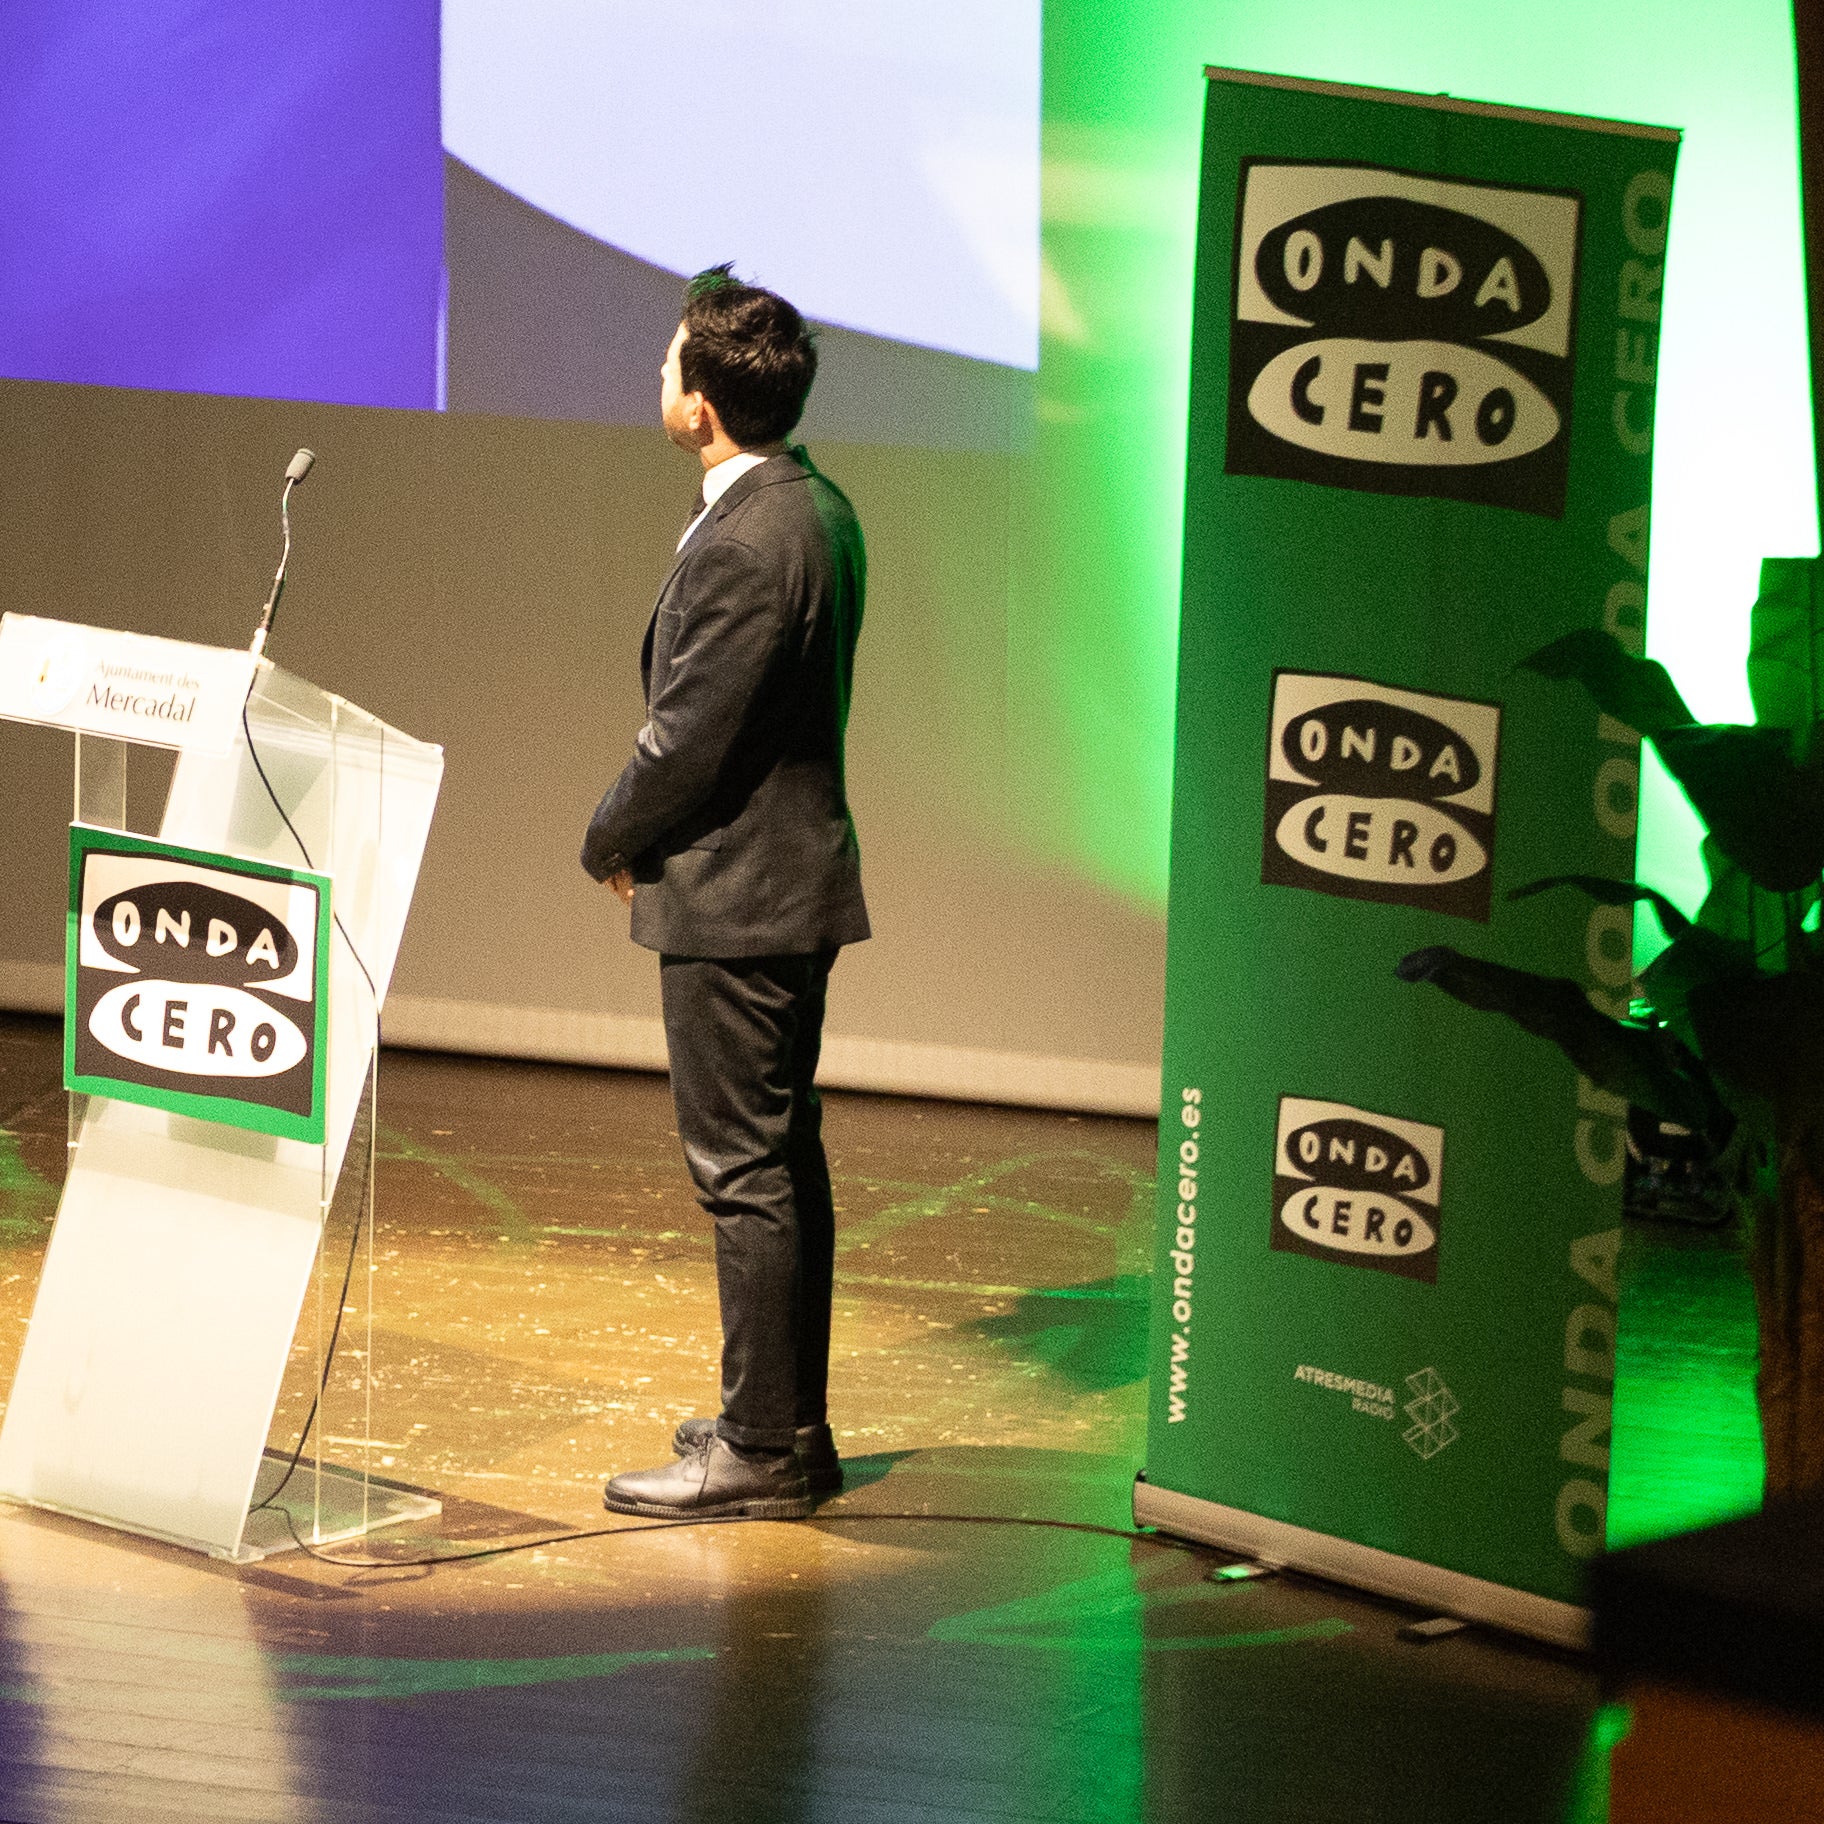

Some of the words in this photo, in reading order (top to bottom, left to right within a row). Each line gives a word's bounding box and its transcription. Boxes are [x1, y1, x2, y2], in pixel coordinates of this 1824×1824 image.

[1283, 228, 1522, 314] ONDA
[1290, 354, 1516, 447] CERO
[85, 682, 197, 723] Mercadal
[94, 657, 174, 687] Ajuntament
[1298, 718, 1462, 784] ONDA
[1304, 805, 1457, 873] CERO
[111, 900, 280, 970] ONDA
[121, 993, 277, 1063] CERO
[1555, 1227, 1622, 1559] ONDA
[1593, 504, 1649, 840] ODA
[1298, 1130, 1419, 1184] ONDA
[1303, 1194, 1413, 1248] CERO
[1167, 1086, 1203, 1424] www.ondacero.es
[1293, 1363, 1396, 1406] ATRESMEDIA
[1352, 1396, 1396, 1422] RADIO
